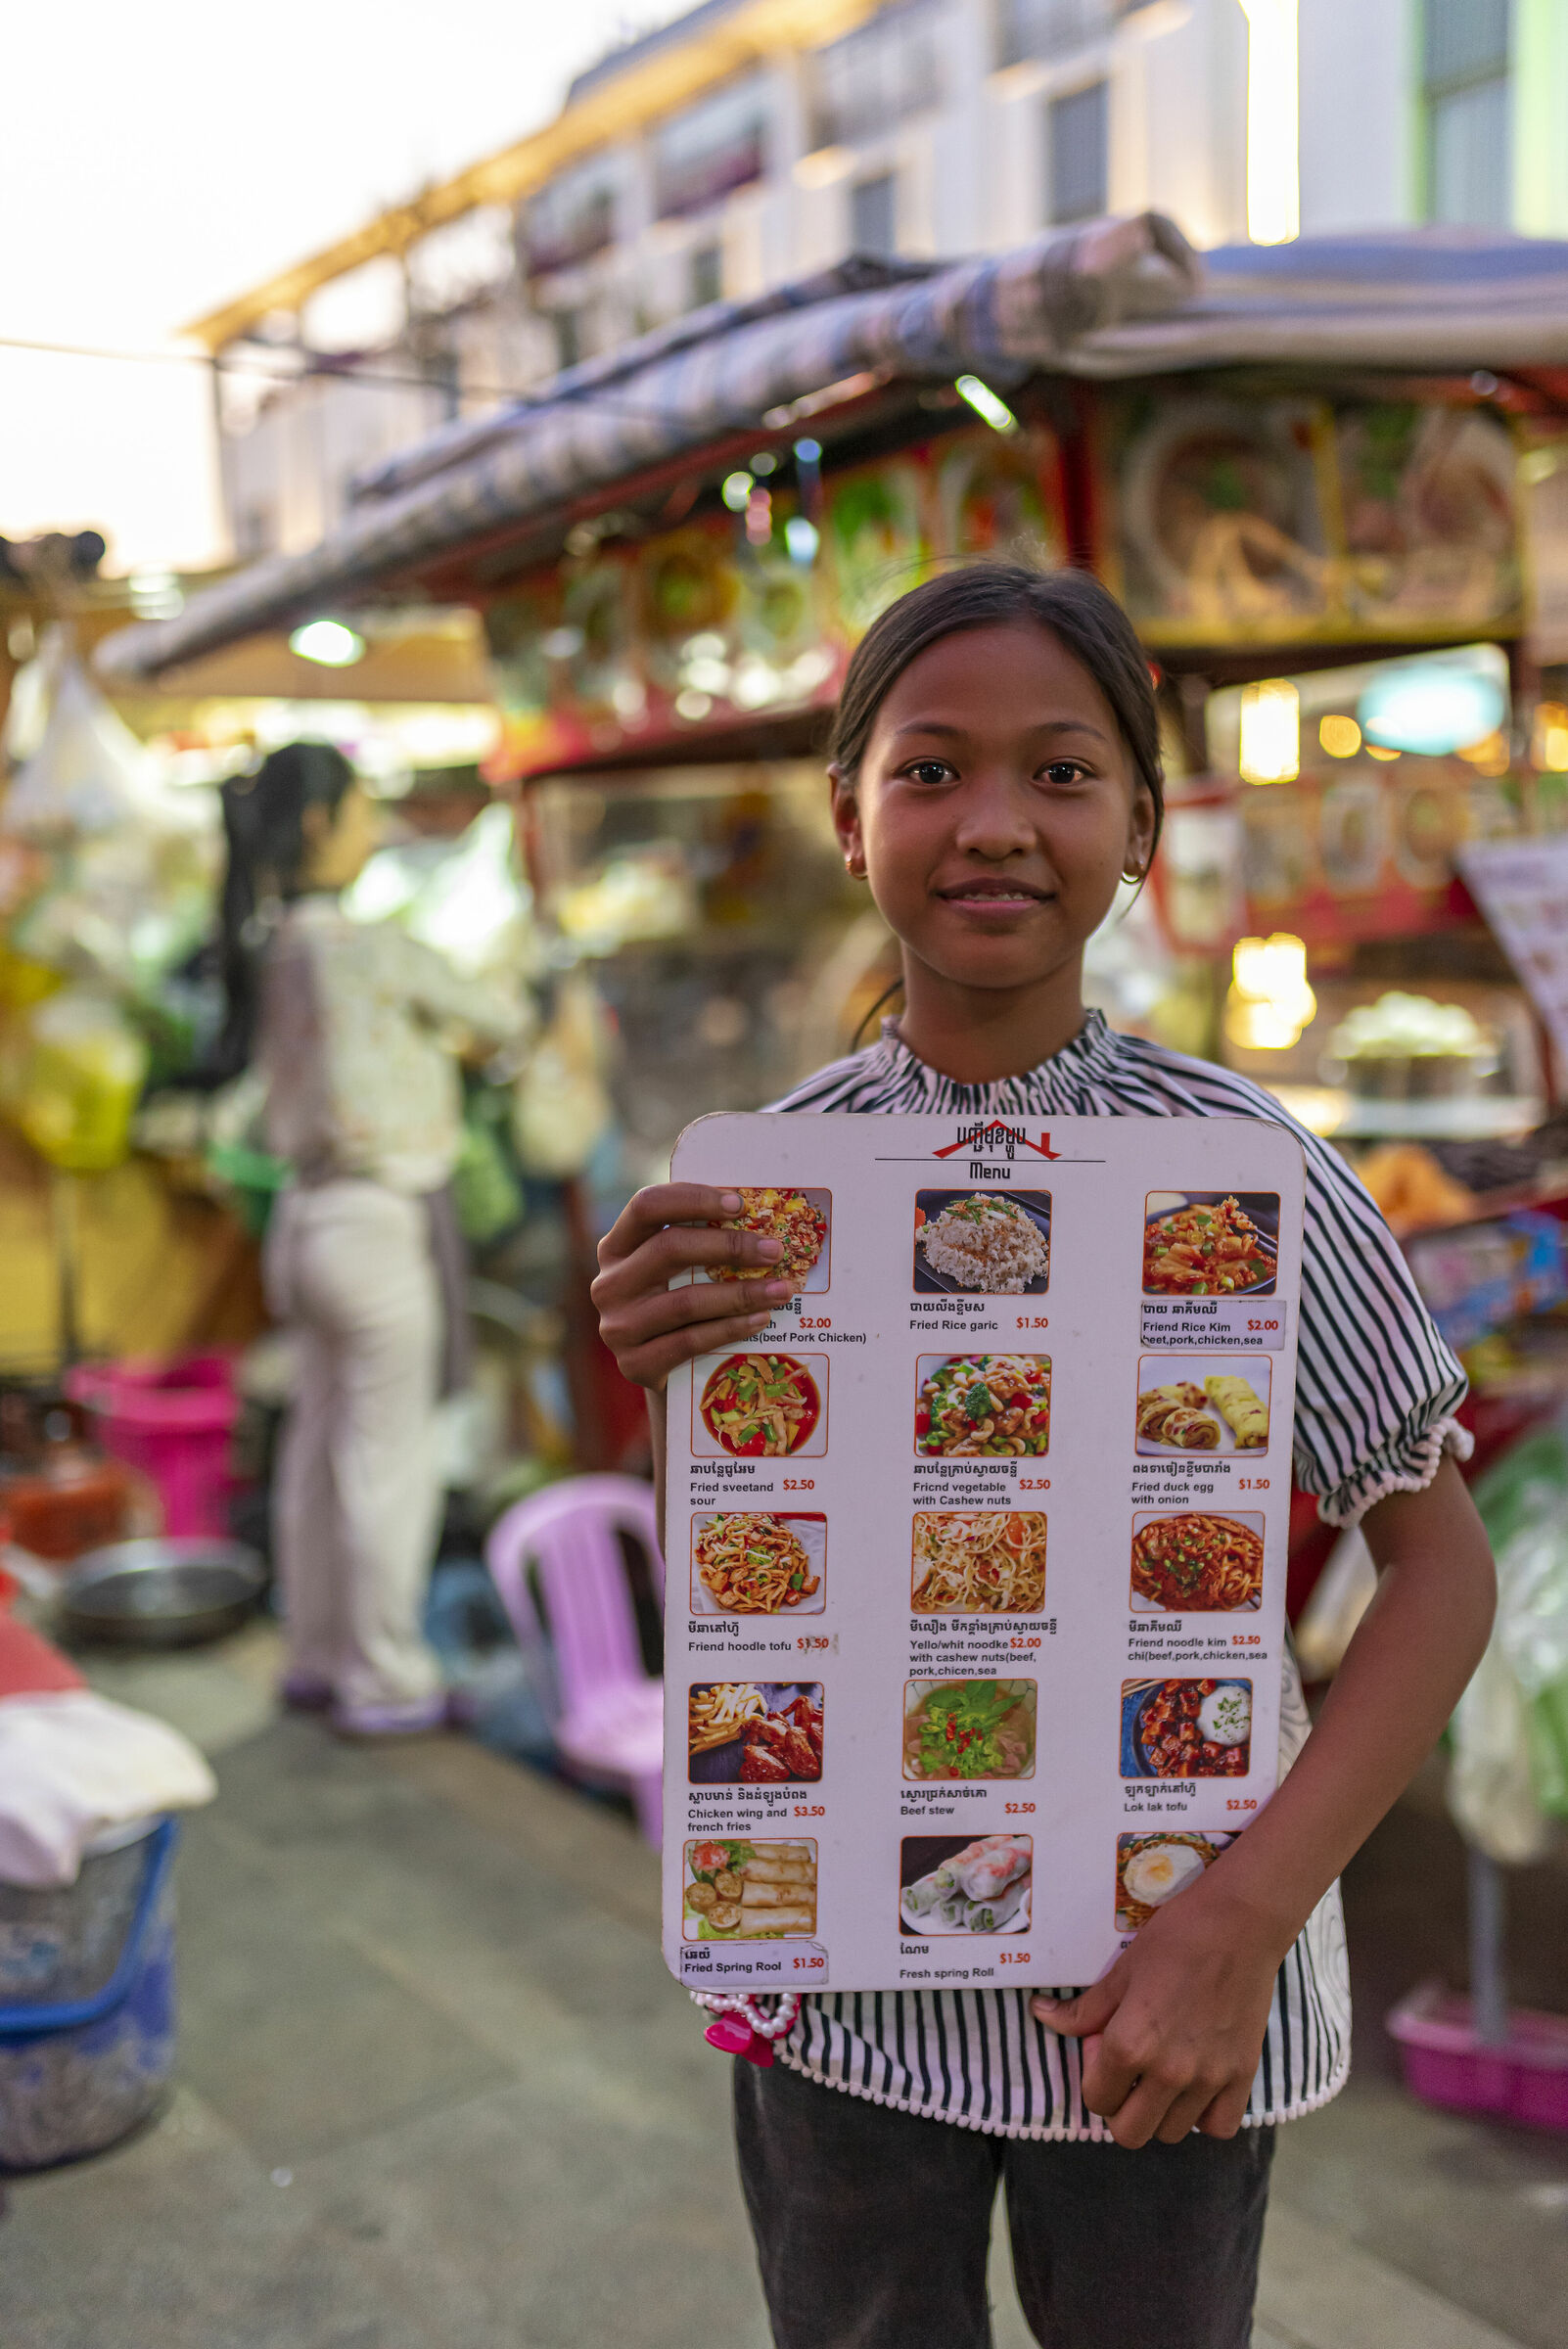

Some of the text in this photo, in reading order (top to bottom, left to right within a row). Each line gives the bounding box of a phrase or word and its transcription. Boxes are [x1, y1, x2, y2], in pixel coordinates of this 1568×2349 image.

[970, 1162, 1011, 1178] Menu
[799, 1317, 832, 1329] $2.00
[909, 1320, 998, 1332] Fried Rice garic
[1016, 1317, 1048, 1329] $1.50
[1142, 1322, 1231, 1332] Friend Rice Kim
[1247, 1319, 1279, 1331] $2.00
[790, 1333, 815, 1343] Pork
[818, 1333, 867, 1345] Chicken)
[690, 1482, 719, 1492] Fried
[783, 1478, 815, 1491] $2.50
[952, 1482, 1006, 1494] vegetable
[1019, 1479, 1051, 1491] $2.50
[1131, 1482, 1215, 1494] Fried duck egg
[1238, 1478, 1270, 1490] $1.50
[913, 1496, 1011, 1505] with Cashew nuts
[1131, 1495, 1189, 1504] with onion
[688, 1642, 724, 1651] Friend
[769, 1641, 792, 1651] tofu
[797, 1637, 830, 1649] $1.50
[1010, 1636, 1042, 1648] $2.00
[1129, 1637, 1227, 1647] Friend noodle kim
[1231, 1635, 1262, 1646] $2.50
[909, 1652, 933, 1662] with
[936, 1652, 978, 1662] cashew
[1004, 1803, 1037, 1814] $2.50
[1124, 1803, 1144, 1812] Lok
[1166, 1802, 1188, 1811] tofu
[1225, 1799, 1258, 1811] $2.50
[688, 1808, 788, 1819] Chicken wing and
[794, 1806, 825, 1817] $3.50
[900, 1806, 955, 1816] Beef stew
[688, 1821, 752, 1831] french fries
[793, 1958, 825, 1969] $1.50
[999, 1953, 1031, 1964] $1.50
[684, 1961, 782, 1973] Fried Spring Rool
[899, 1967, 994, 1979] Fresh spring Roll
